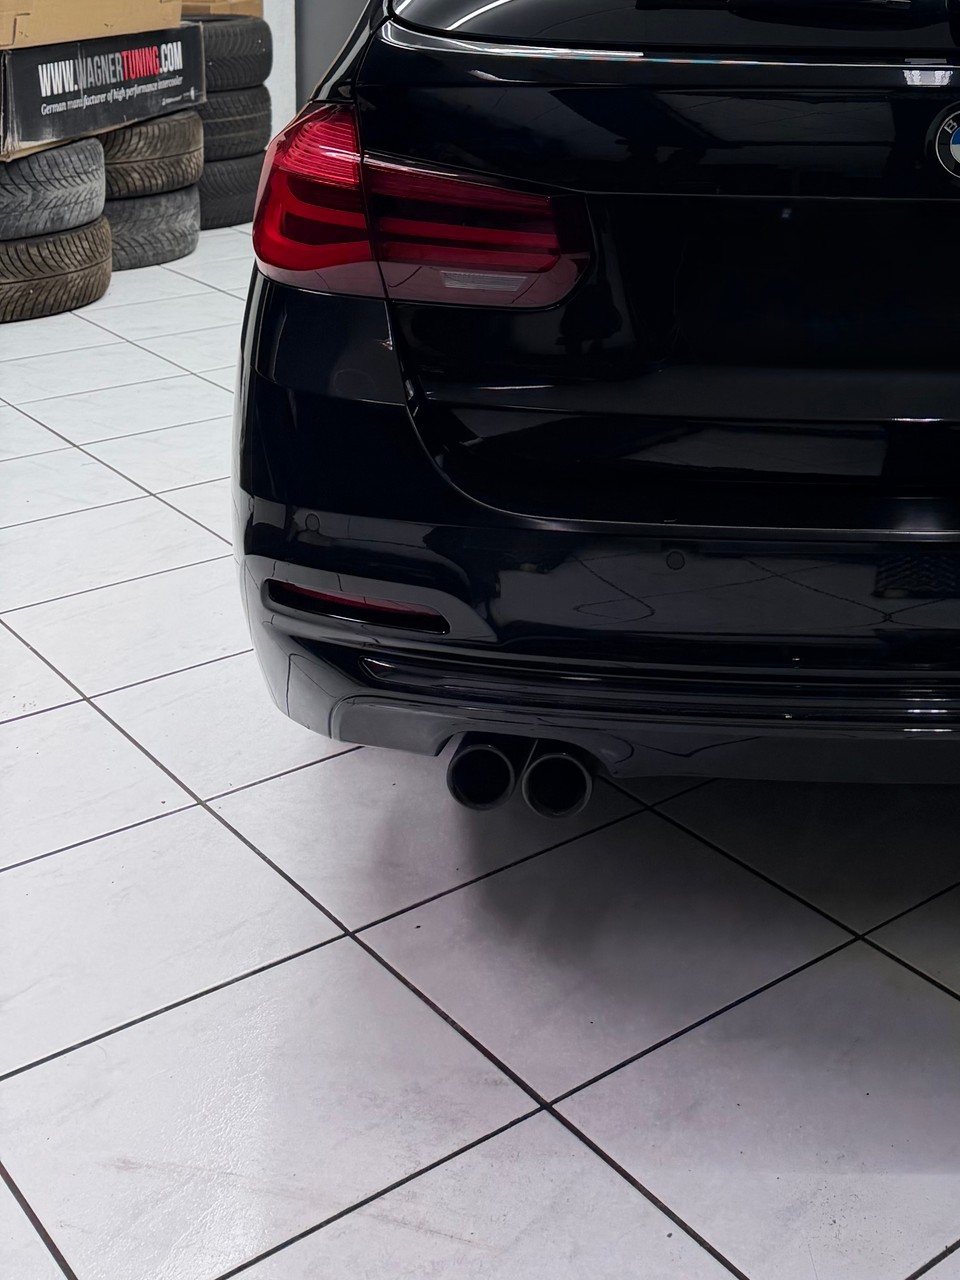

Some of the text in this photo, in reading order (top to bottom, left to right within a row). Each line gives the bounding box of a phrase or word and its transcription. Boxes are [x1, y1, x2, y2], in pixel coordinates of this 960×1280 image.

[38, 41, 183, 97] WWW.WAGNERTUNING.COM
[41, 103, 67, 115] German
[113, 87, 126, 102] high
[126, 84, 158, 100] performance
